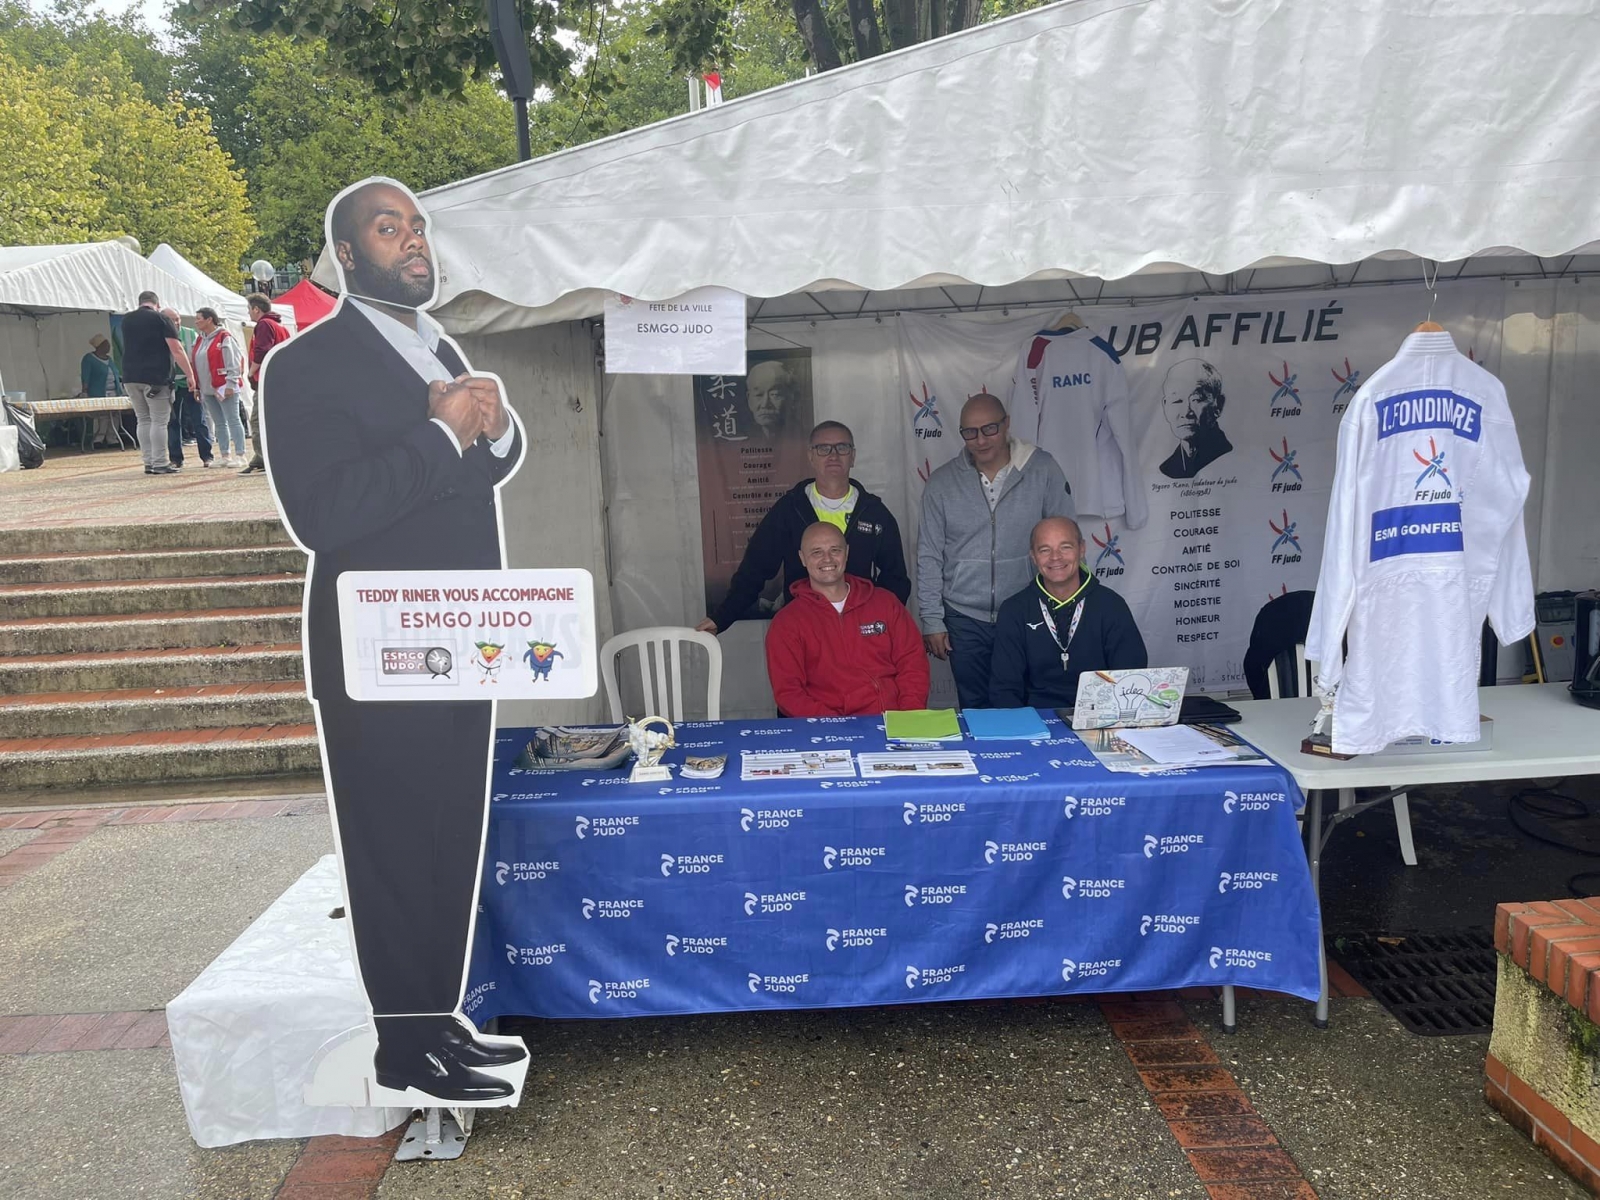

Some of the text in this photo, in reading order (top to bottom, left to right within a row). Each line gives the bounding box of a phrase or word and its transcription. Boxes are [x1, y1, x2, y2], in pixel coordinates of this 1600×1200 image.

[668, 304, 678, 312] DE
[637, 323, 713, 334] ESMGO JUDO
[1108, 300, 1344, 356] UB AFFILIÉ
[1053, 373, 1091, 388] RANC
[1281, 406, 1302, 418] judo
[923, 428, 942, 439] judo
[1282, 482, 1302, 494] judo
[1415, 490, 1452, 502] FF judo
[1170, 508, 1221, 520] POLITESSE
[1174, 526, 1219, 537] COURAGE
[1375, 530, 1397, 542] ESM
[1281, 553, 1302, 565] judo
[1207, 562, 1220, 570] DE
[1224, 560, 1240, 568] SOI
[1106, 566, 1124, 578] judo
[1174, 578, 1220, 591] SINCÉRITÉ
[356, 588, 574, 602] TEDDY RINER VOUS ACCOMPAGNE
[1174, 597, 1221, 608] MODESTIE
[400, 611, 532, 628] ESMGO JUDO
[1176, 614, 1220, 626] HONNEUR
[1177, 632, 1219, 643] RESPECT
[383, 651, 424, 660] ESMGO
[385, 662, 415, 670] JUDO
[1120, 683, 1144, 697] idea
[1081, 797, 1125, 806] FRANCE
[1240, 793, 1285, 802] FRANCE
[920, 803, 965, 813] FRANCE
[1081, 806, 1111, 816] JUDO
[1240, 802, 1269, 811] JUDO
[758, 809, 803, 819] FRANCE
[920, 813, 951, 822] JUDO
[593, 816, 639, 826] FRANCE
[758, 819, 789, 829] JUDO
[594, 827, 625, 836] JUDO
[1161, 835, 1203, 845] FRANCE
[840, 847, 885, 857] FRANCE
[1002, 842, 1047, 852] FRANCE
[1160, 844, 1188, 855] JUDO
[678, 854, 724, 865] FRANCE
[840, 857, 871, 866] JUDO
[1002, 851, 1033, 862] JUDO
[513, 861, 559, 871] FRANCE
[678, 864, 710, 873] JUDO
[513, 871, 546, 881] JUDO
[1233, 872, 1278, 881] FRANCE
[1079, 879, 1124, 888] FRANCE
[1233, 881, 1262, 889] JUDO
[921, 885, 966, 895] FRANCE
[1079, 889, 1110, 897] JUDO
[761, 892, 806, 903] FRANCE
[921, 895, 952, 904] JUDO
[599, 900, 644, 908] FRANCE
[761, 902, 792, 912] JUDO
[599, 909, 630, 917] JUDO
[1154, 915, 1200, 924] FRANCE
[1000, 920, 1044, 931] FRANCE
[1154, 924, 1185, 933] JUDO
[843, 928, 886, 937] FRANCE
[1000, 929, 1030, 940] JUDO
[682, 937, 727, 946] FRANCE
[843, 937, 872, 947] JUDO
[520, 944, 566, 957] FRANCE
[683, 946, 713, 954] JUDO
[1225, 949, 1271, 961] FRANCE
[521, 956, 552, 965] JUDO
[1079, 960, 1121, 970] FRANCE
[1225, 959, 1256, 968] JUDO
[922, 964, 965, 977] FRANCE
[1078, 968, 1107, 977] JUDO
[764, 974, 809, 984] FRANCE
[922, 975, 951, 985] JUDO
[605, 979, 649, 990] FRANCE
[765, 984, 795, 992] JUDO
[463, 981, 496, 1007] FRANCE
[606, 989, 636, 999] JUDO
[465, 996, 483, 1015] JUDO
